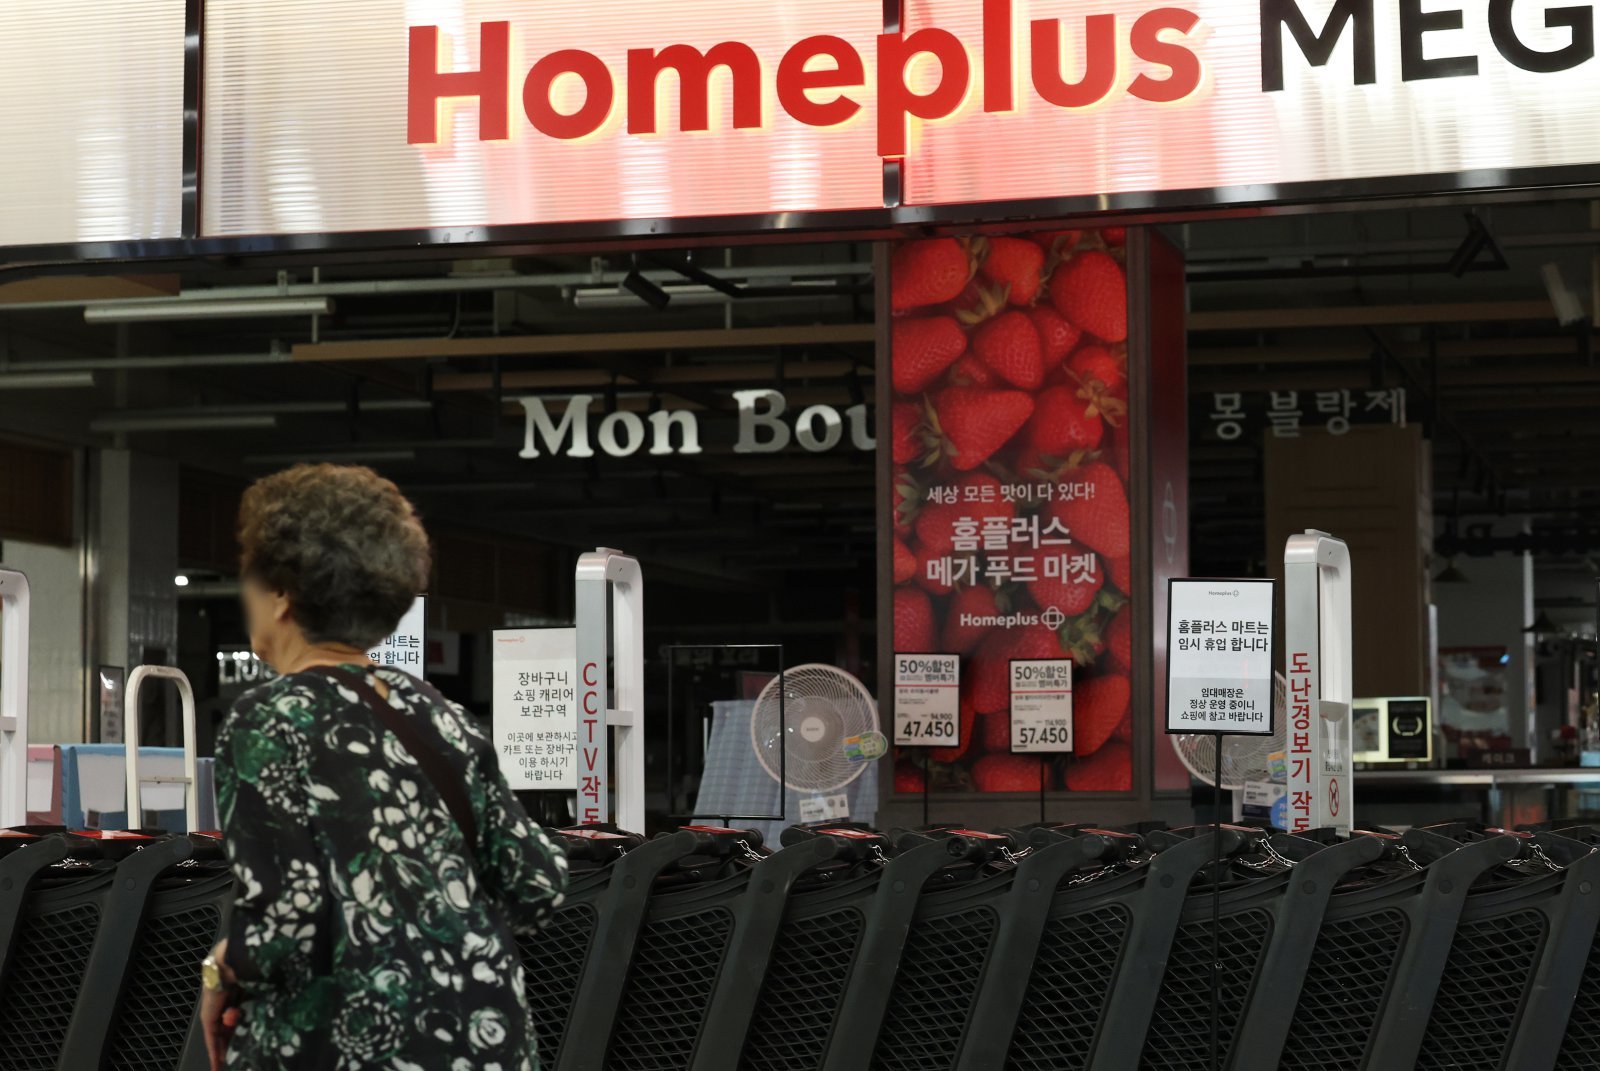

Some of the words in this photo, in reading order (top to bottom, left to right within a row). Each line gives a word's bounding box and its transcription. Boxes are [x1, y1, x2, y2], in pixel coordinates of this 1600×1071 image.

[407, 0, 1202, 156] Homeplus
[1261, 0, 1595, 93] MEG
[519, 394, 702, 458] Mon
[927, 485, 959, 504] 세상
[964, 485, 995, 503] 모든
[1000, 484, 1032, 502] 맛이
[1037, 483, 1053, 501] 다
[1057, 482, 1096, 501] 있다!
[950, 515, 1071, 551] 홈플러스
[926, 555, 980, 587] 메가
[984, 556, 1038, 586] 푸드
[1043, 552, 1096, 584] 마켓
[960, 612, 1039, 629] Homeplus
[1178, 620, 1228, 634] 홈플러스
[1231, 620, 1270, 634] 마트는
[1178, 638, 1200, 651] 임시
[1204, 638, 1227, 651] 휴업
[1230, 637, 1269, 652] 합니다
[384, 650, 420, 665] 합니다
[899, 659, 955, 673] 50%할인
[1015, 665, 1067, 680] 50%할인
[518, 671, 569, 686] 장바구니
[513, 689, 536, 702] 쇼핑
[539, 688, 574, 702] 캐리어
[1201, 687, 1244, 698] 임대매장은
[520, 704, 566, 718] 보관구역
[1189, 699, 1206, 711] 정상
[1209, 699, 1226, 711] 운영
[1229, 699, 1255, 711] 중이니
[1180, 711, 1206, 722] 쇼핑에
[1209, 711, 1226, 722] 참고
[1228, 710, 1263, 722] 바랍니다
[1289, 652, 1313, 784] 도난경보기
[507, 732, 534, 742] 이곳에
[503, 744, 522, 755] 카트
[525, 744, 543, 755] 또는
[546, 743, 577, 755] 장바구
[519, 757, 537, 768] 이용
[541, 756, 568, 768] 하시기
[524, 769, 563, 781] 바랍니다
